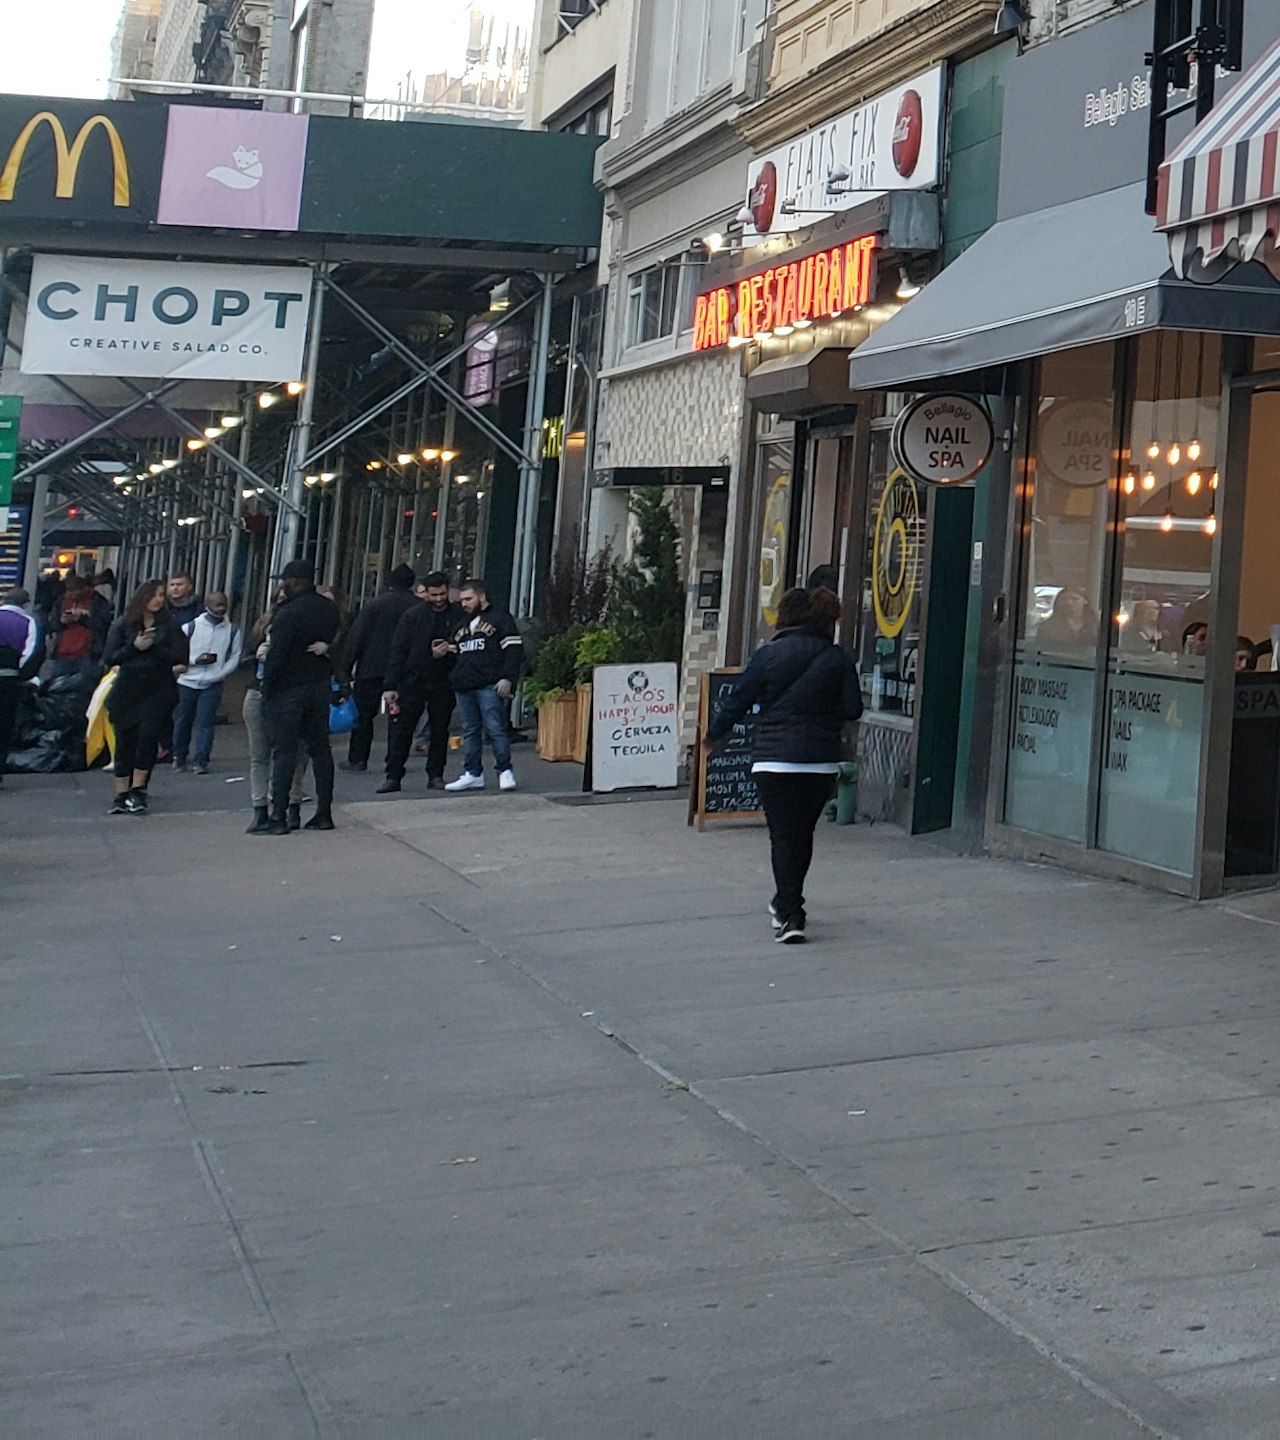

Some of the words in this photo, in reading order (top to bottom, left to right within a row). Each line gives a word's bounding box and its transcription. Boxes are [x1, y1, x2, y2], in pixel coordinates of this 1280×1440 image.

[1084, 82, 1128, 127] Bellagio
[850, 103, 879, 167] FIX
[692, 289, 730, 352] BAR
[738, 233, 877, 336] RESTAURANT
[37, 281, 303, 329] CHOPT
[69, 337, 162, 351] CREATIVE
[172, 342, 229, 353] SALAD
[239, 344, 269, 355] CO.
[924, 403, 972, 422] Bellagio
[925, 427, 971, 445] NAIL
[928, 451, 965, 469] SPA
[1020, 677, 1036, 696] BODY
[1038, 679, 1068, 700] MASSAGE
[1113, 689, 1127, 710] SPA
[1129, 692, 1161, 714] PACKAGE
[1237, 689, 1279, 711] SPA
[598, 707, 639, 720] HAPPY
[645, 703, 676, 715] HOUR
[612, 725, 671, 740] CERVEZA
[1113, 722, 1132, 742] NAILS
[610, 744, 665, 757] TEQUILA
[1016, 733, 1036, 754] FACIAL
[1111, 752, 1127, 772] WAX
